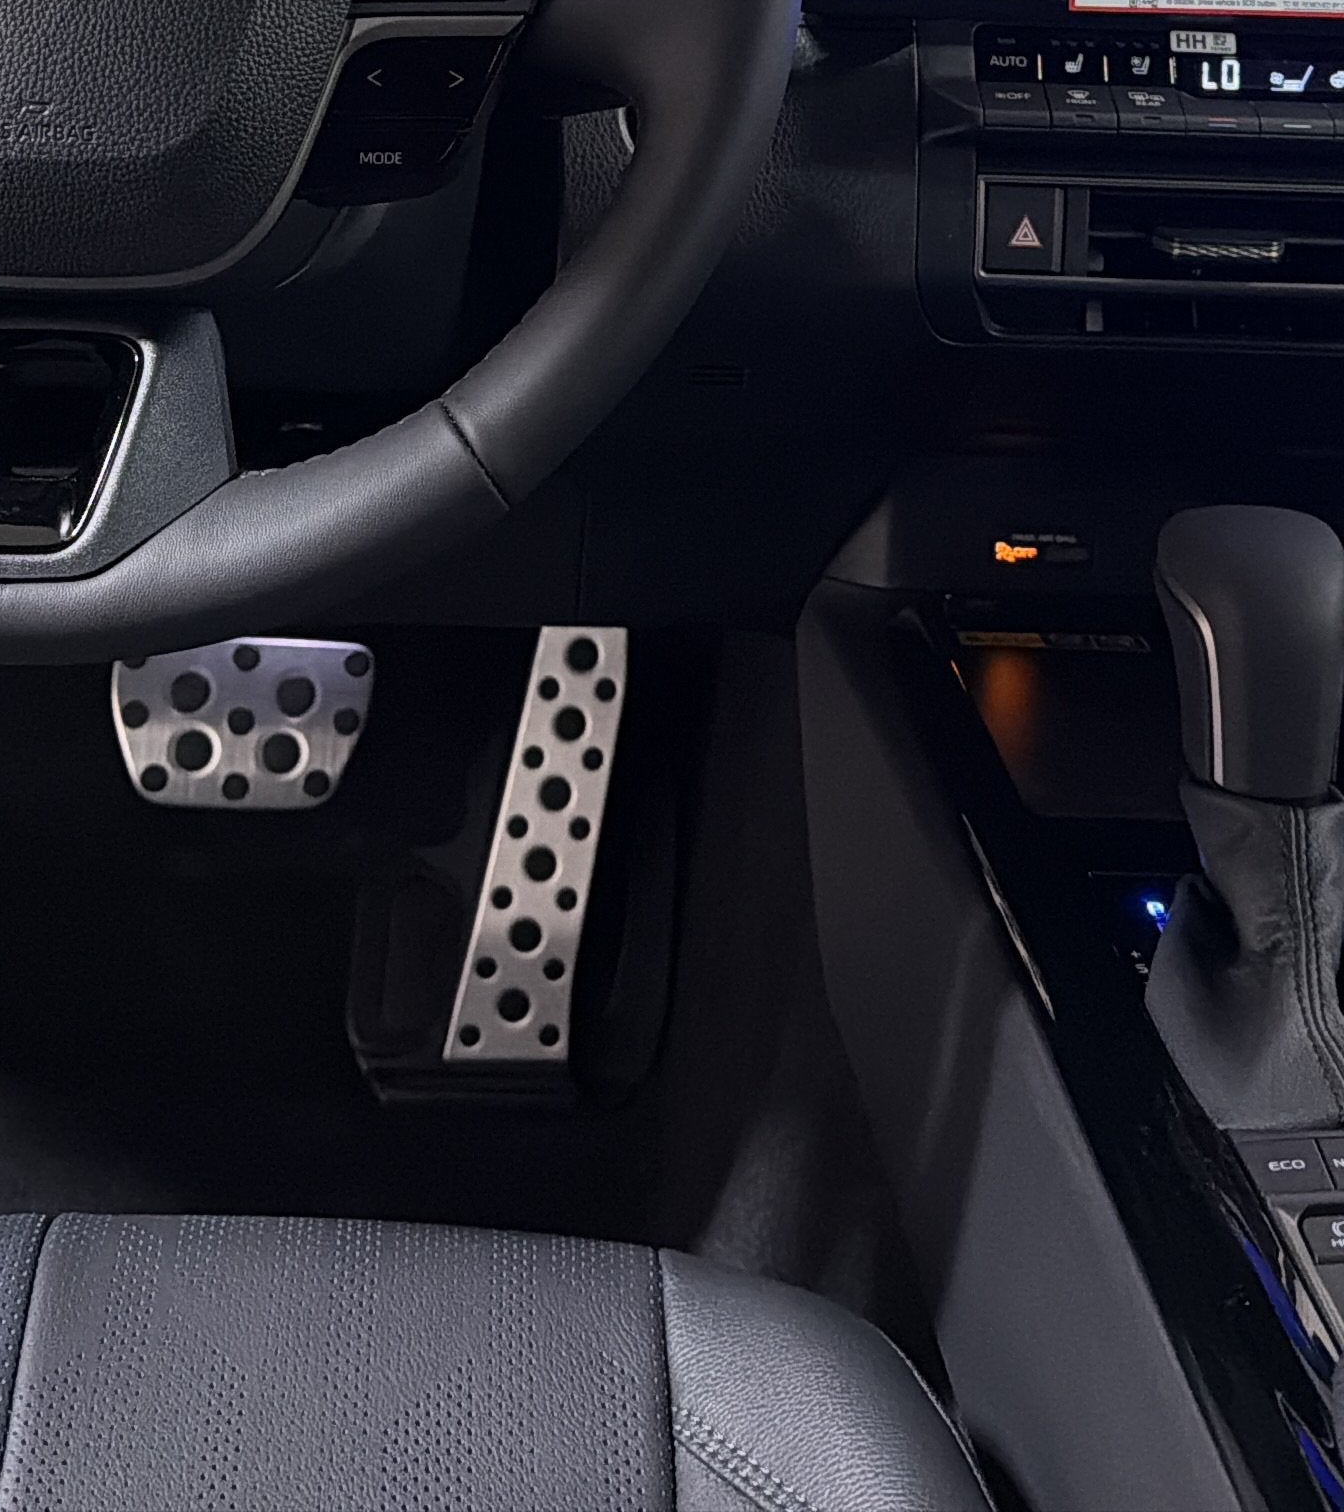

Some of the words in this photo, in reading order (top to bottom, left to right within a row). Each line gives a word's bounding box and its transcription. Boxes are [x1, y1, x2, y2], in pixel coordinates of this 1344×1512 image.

[1176, 33, 1207, 49] HH
[989, 55, 1028, 68] AUTO
[1202, 59, 1241, 90] LO
[1006, 91, 1032, 100] OFF
[17, 122, 97, 144] AIRBAG
[359, 151, 403, 165] MODE
[1268, 1159, 1306, 1172] ECO
